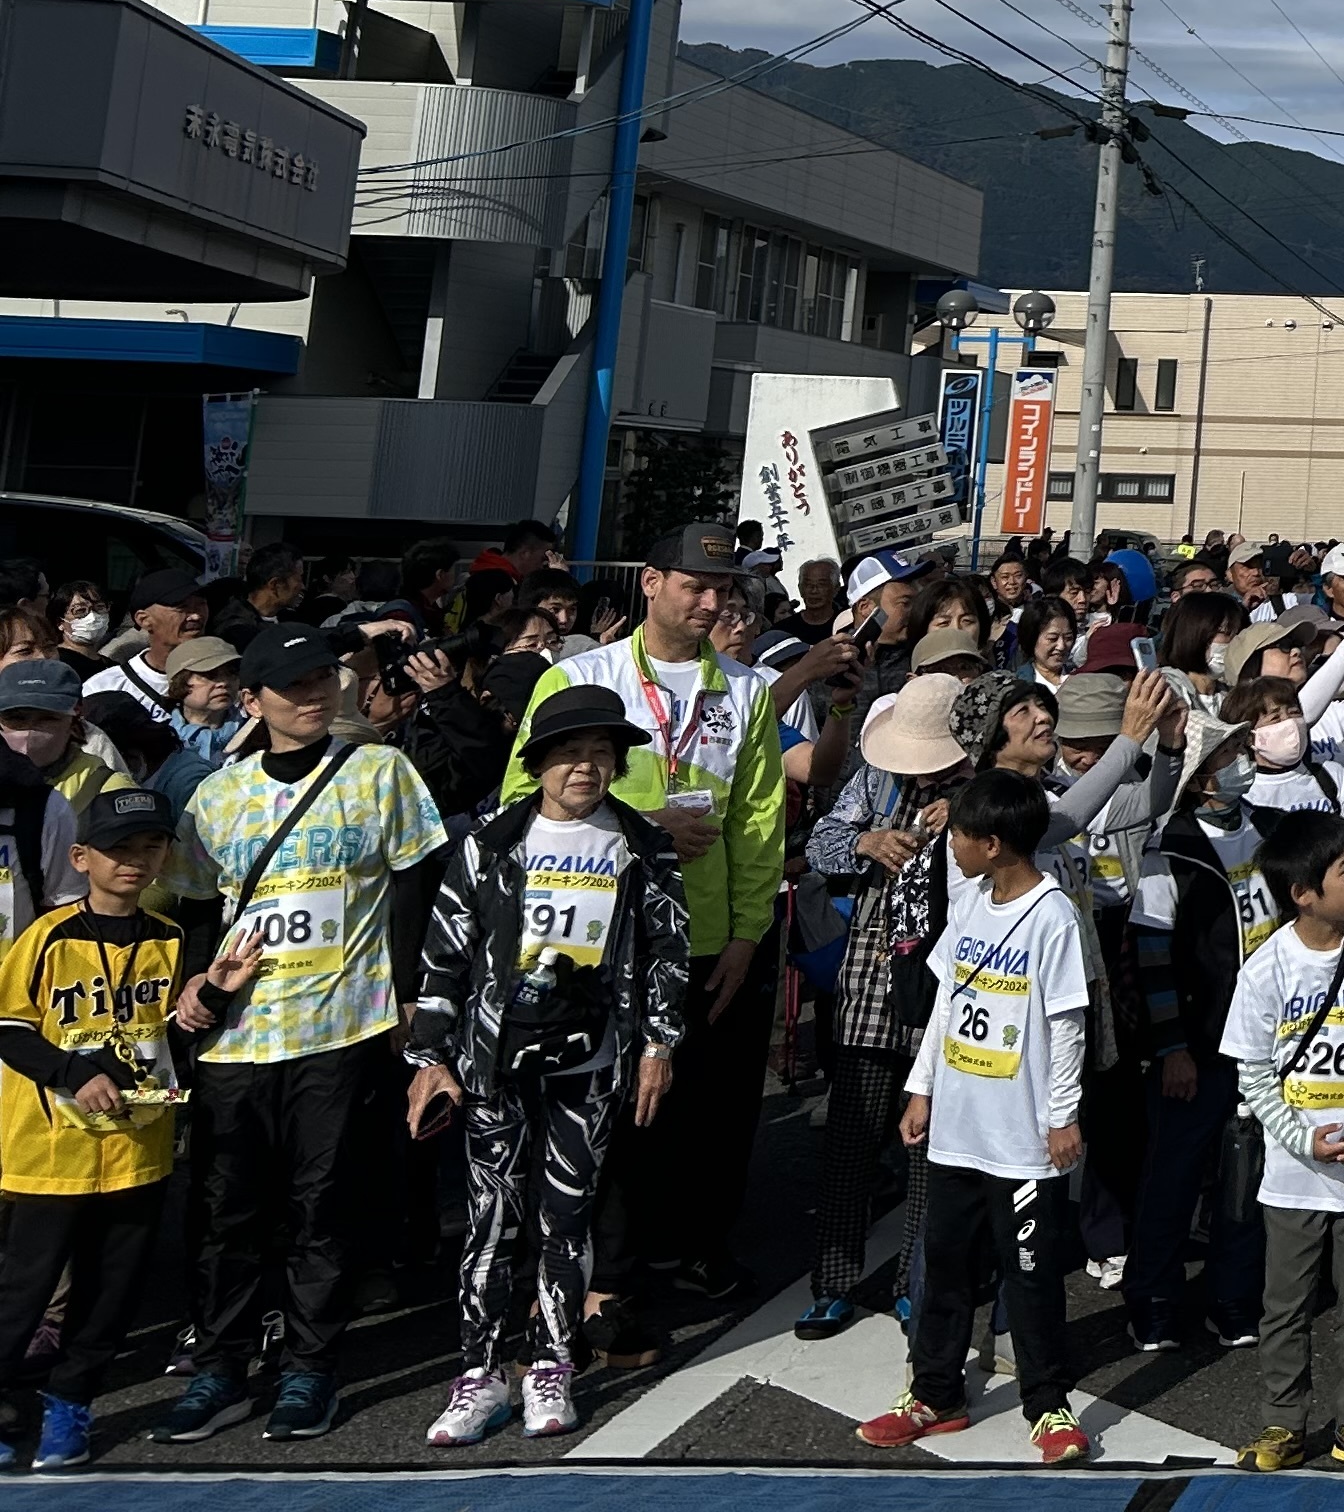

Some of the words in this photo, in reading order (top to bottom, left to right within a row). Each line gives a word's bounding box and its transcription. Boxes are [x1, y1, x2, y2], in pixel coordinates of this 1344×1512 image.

[834, 419, 932, 455] 電気工事
[780, 430, 811, 516] ありがとう
[958, 1002, 990, 1041] 26
